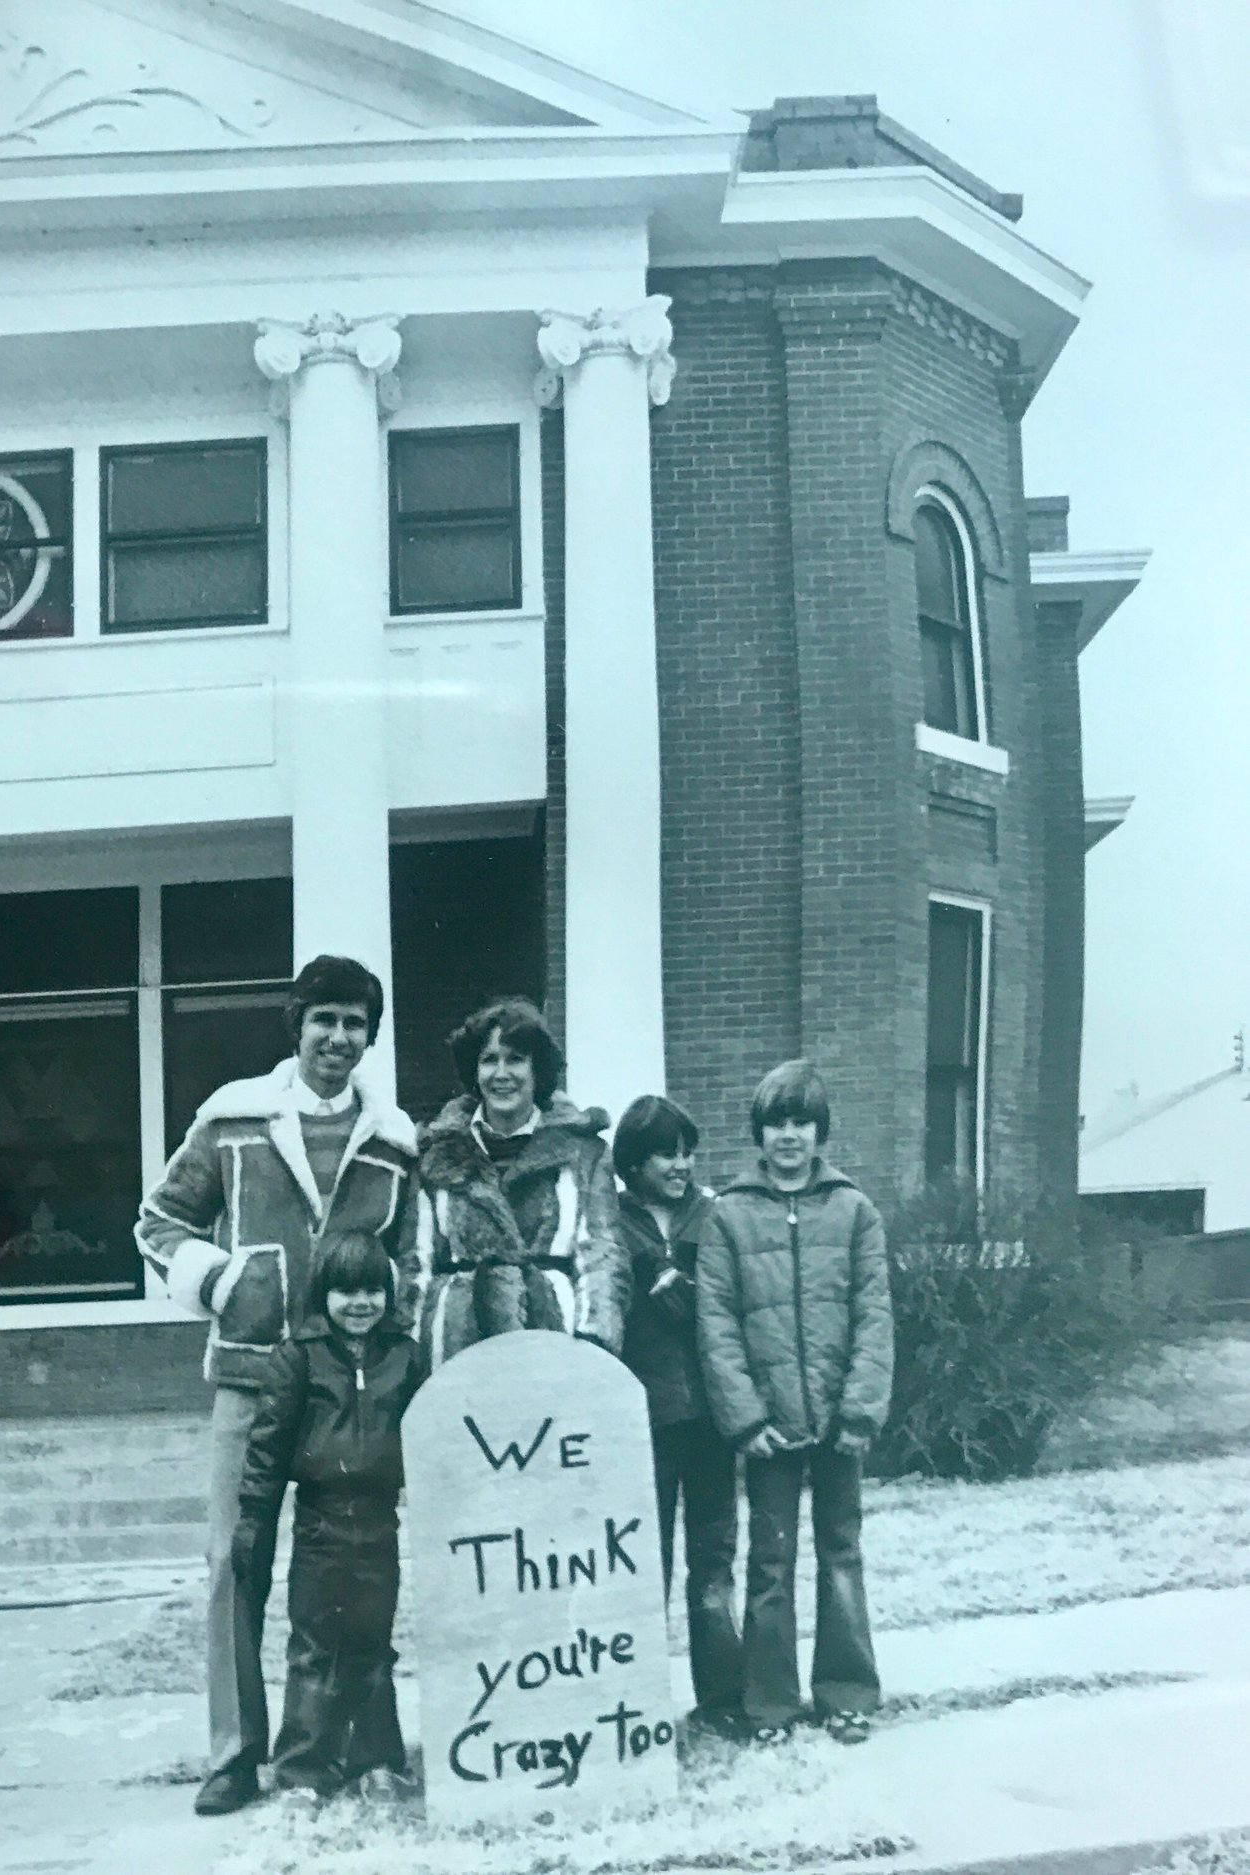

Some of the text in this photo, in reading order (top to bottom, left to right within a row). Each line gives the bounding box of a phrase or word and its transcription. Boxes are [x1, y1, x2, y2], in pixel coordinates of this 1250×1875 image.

[470, 1628, 635, 1720] you're
[449, 1701, 673, 1789] Crazy Too
